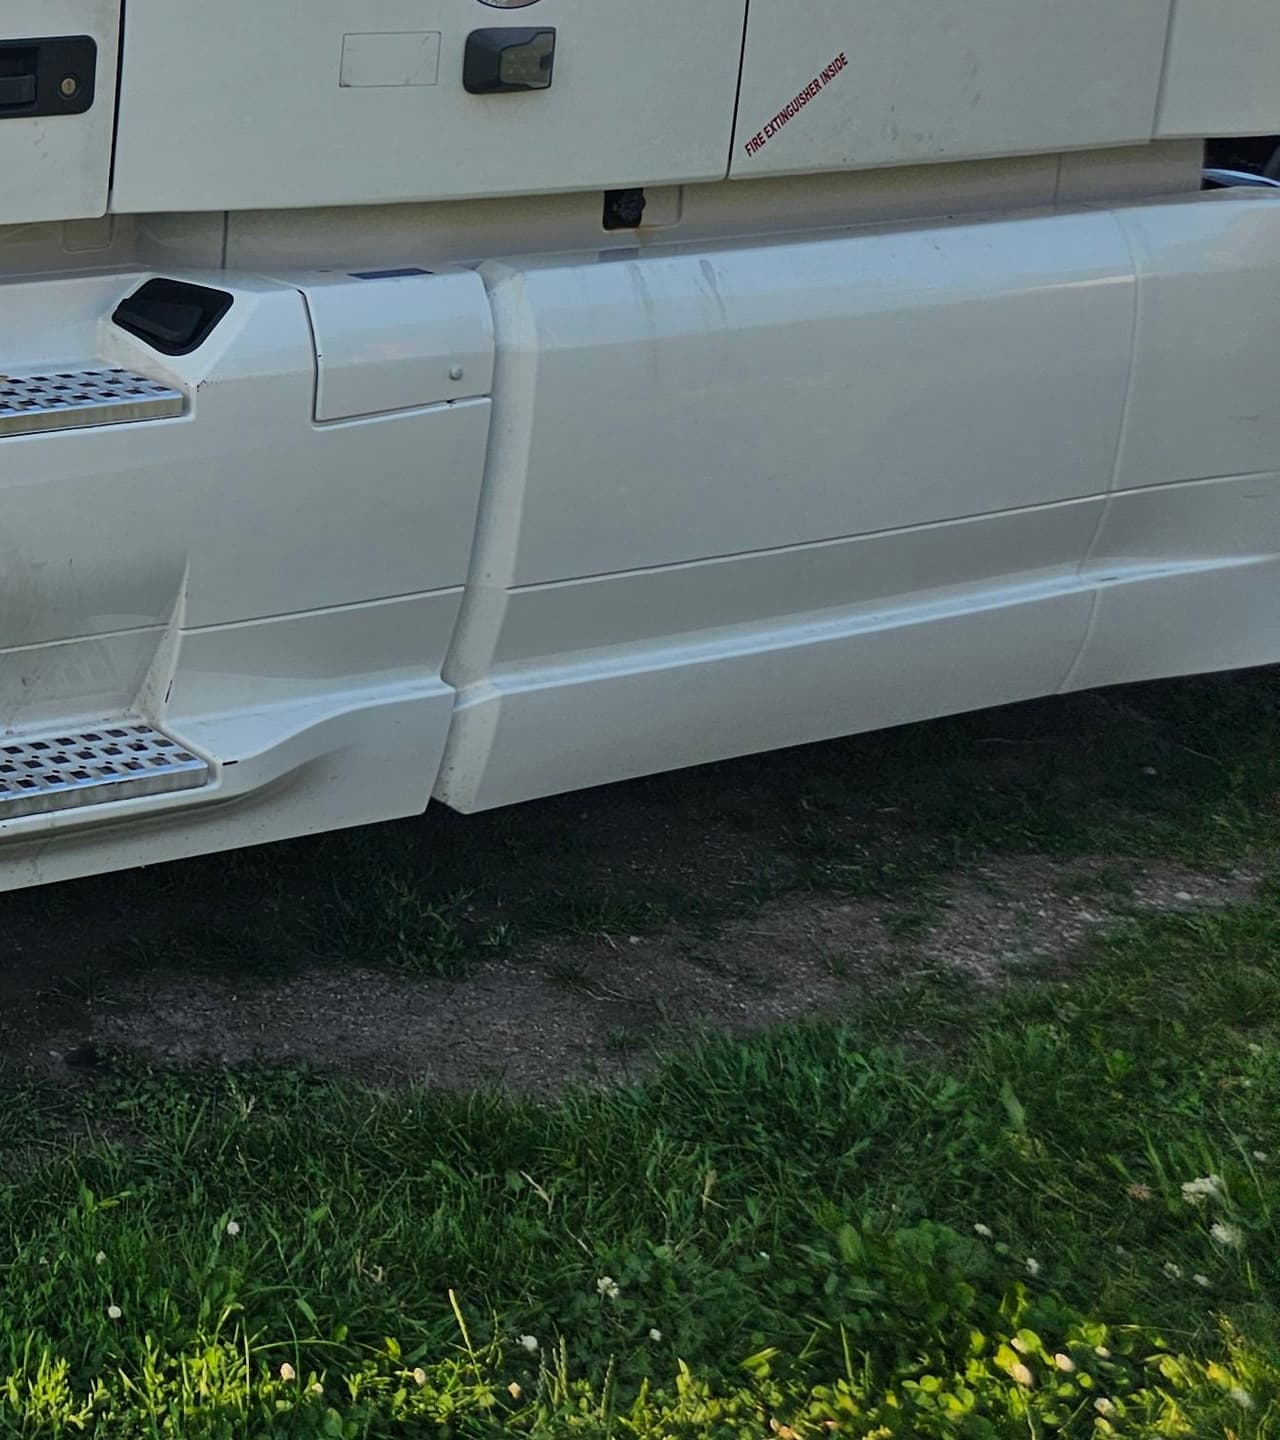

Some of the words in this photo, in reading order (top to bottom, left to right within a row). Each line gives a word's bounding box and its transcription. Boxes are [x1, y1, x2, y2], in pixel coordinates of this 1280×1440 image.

[744, 130, 767, 157] FIRE
[763, 78, 823, 140] EXTINGUISHER
[819, 52, 849, 86] INSIDE
